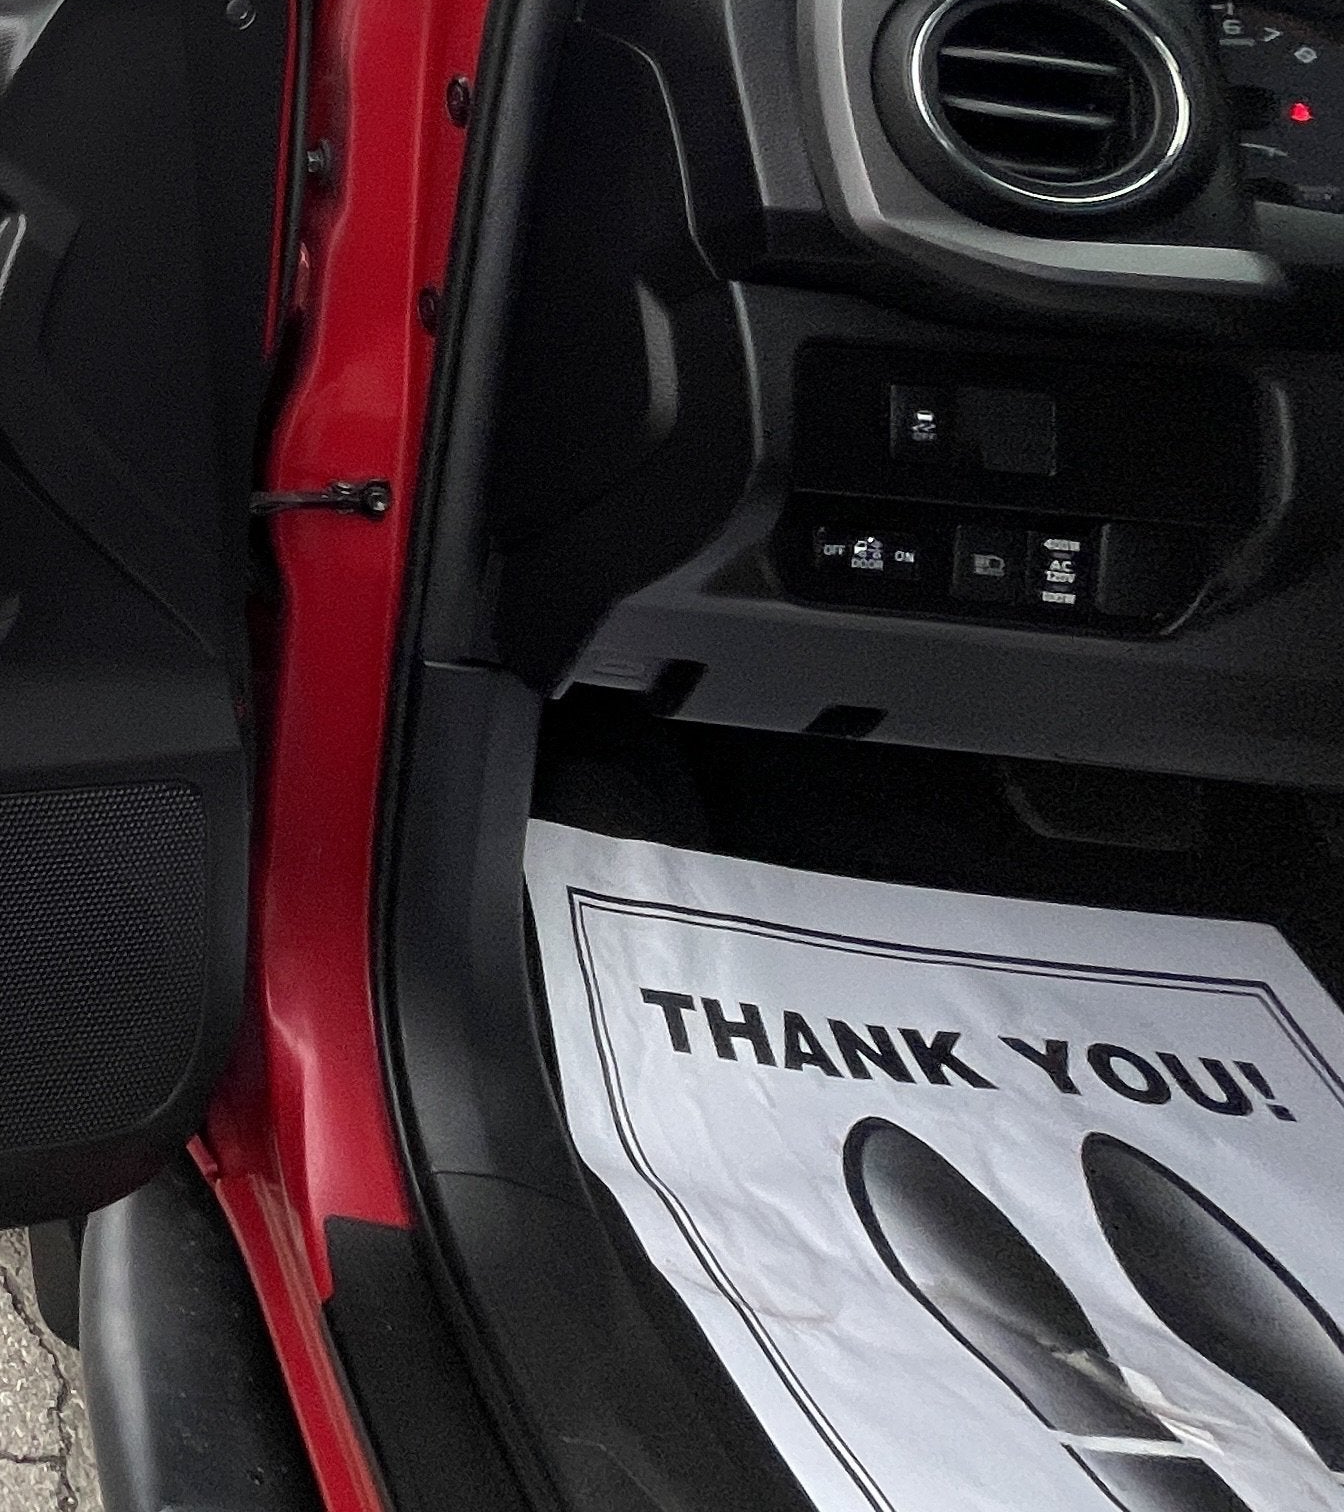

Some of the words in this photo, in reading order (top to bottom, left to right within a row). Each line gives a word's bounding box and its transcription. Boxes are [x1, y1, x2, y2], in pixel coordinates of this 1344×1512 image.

[823, 544, 846, 556] OFF
[894, 550, 915, 563] ON
[1049, 559, 1073, 572] AC
[640, 988, 1000, 1090] THANK
[999, 1035, 1297, 1122] YOU!
